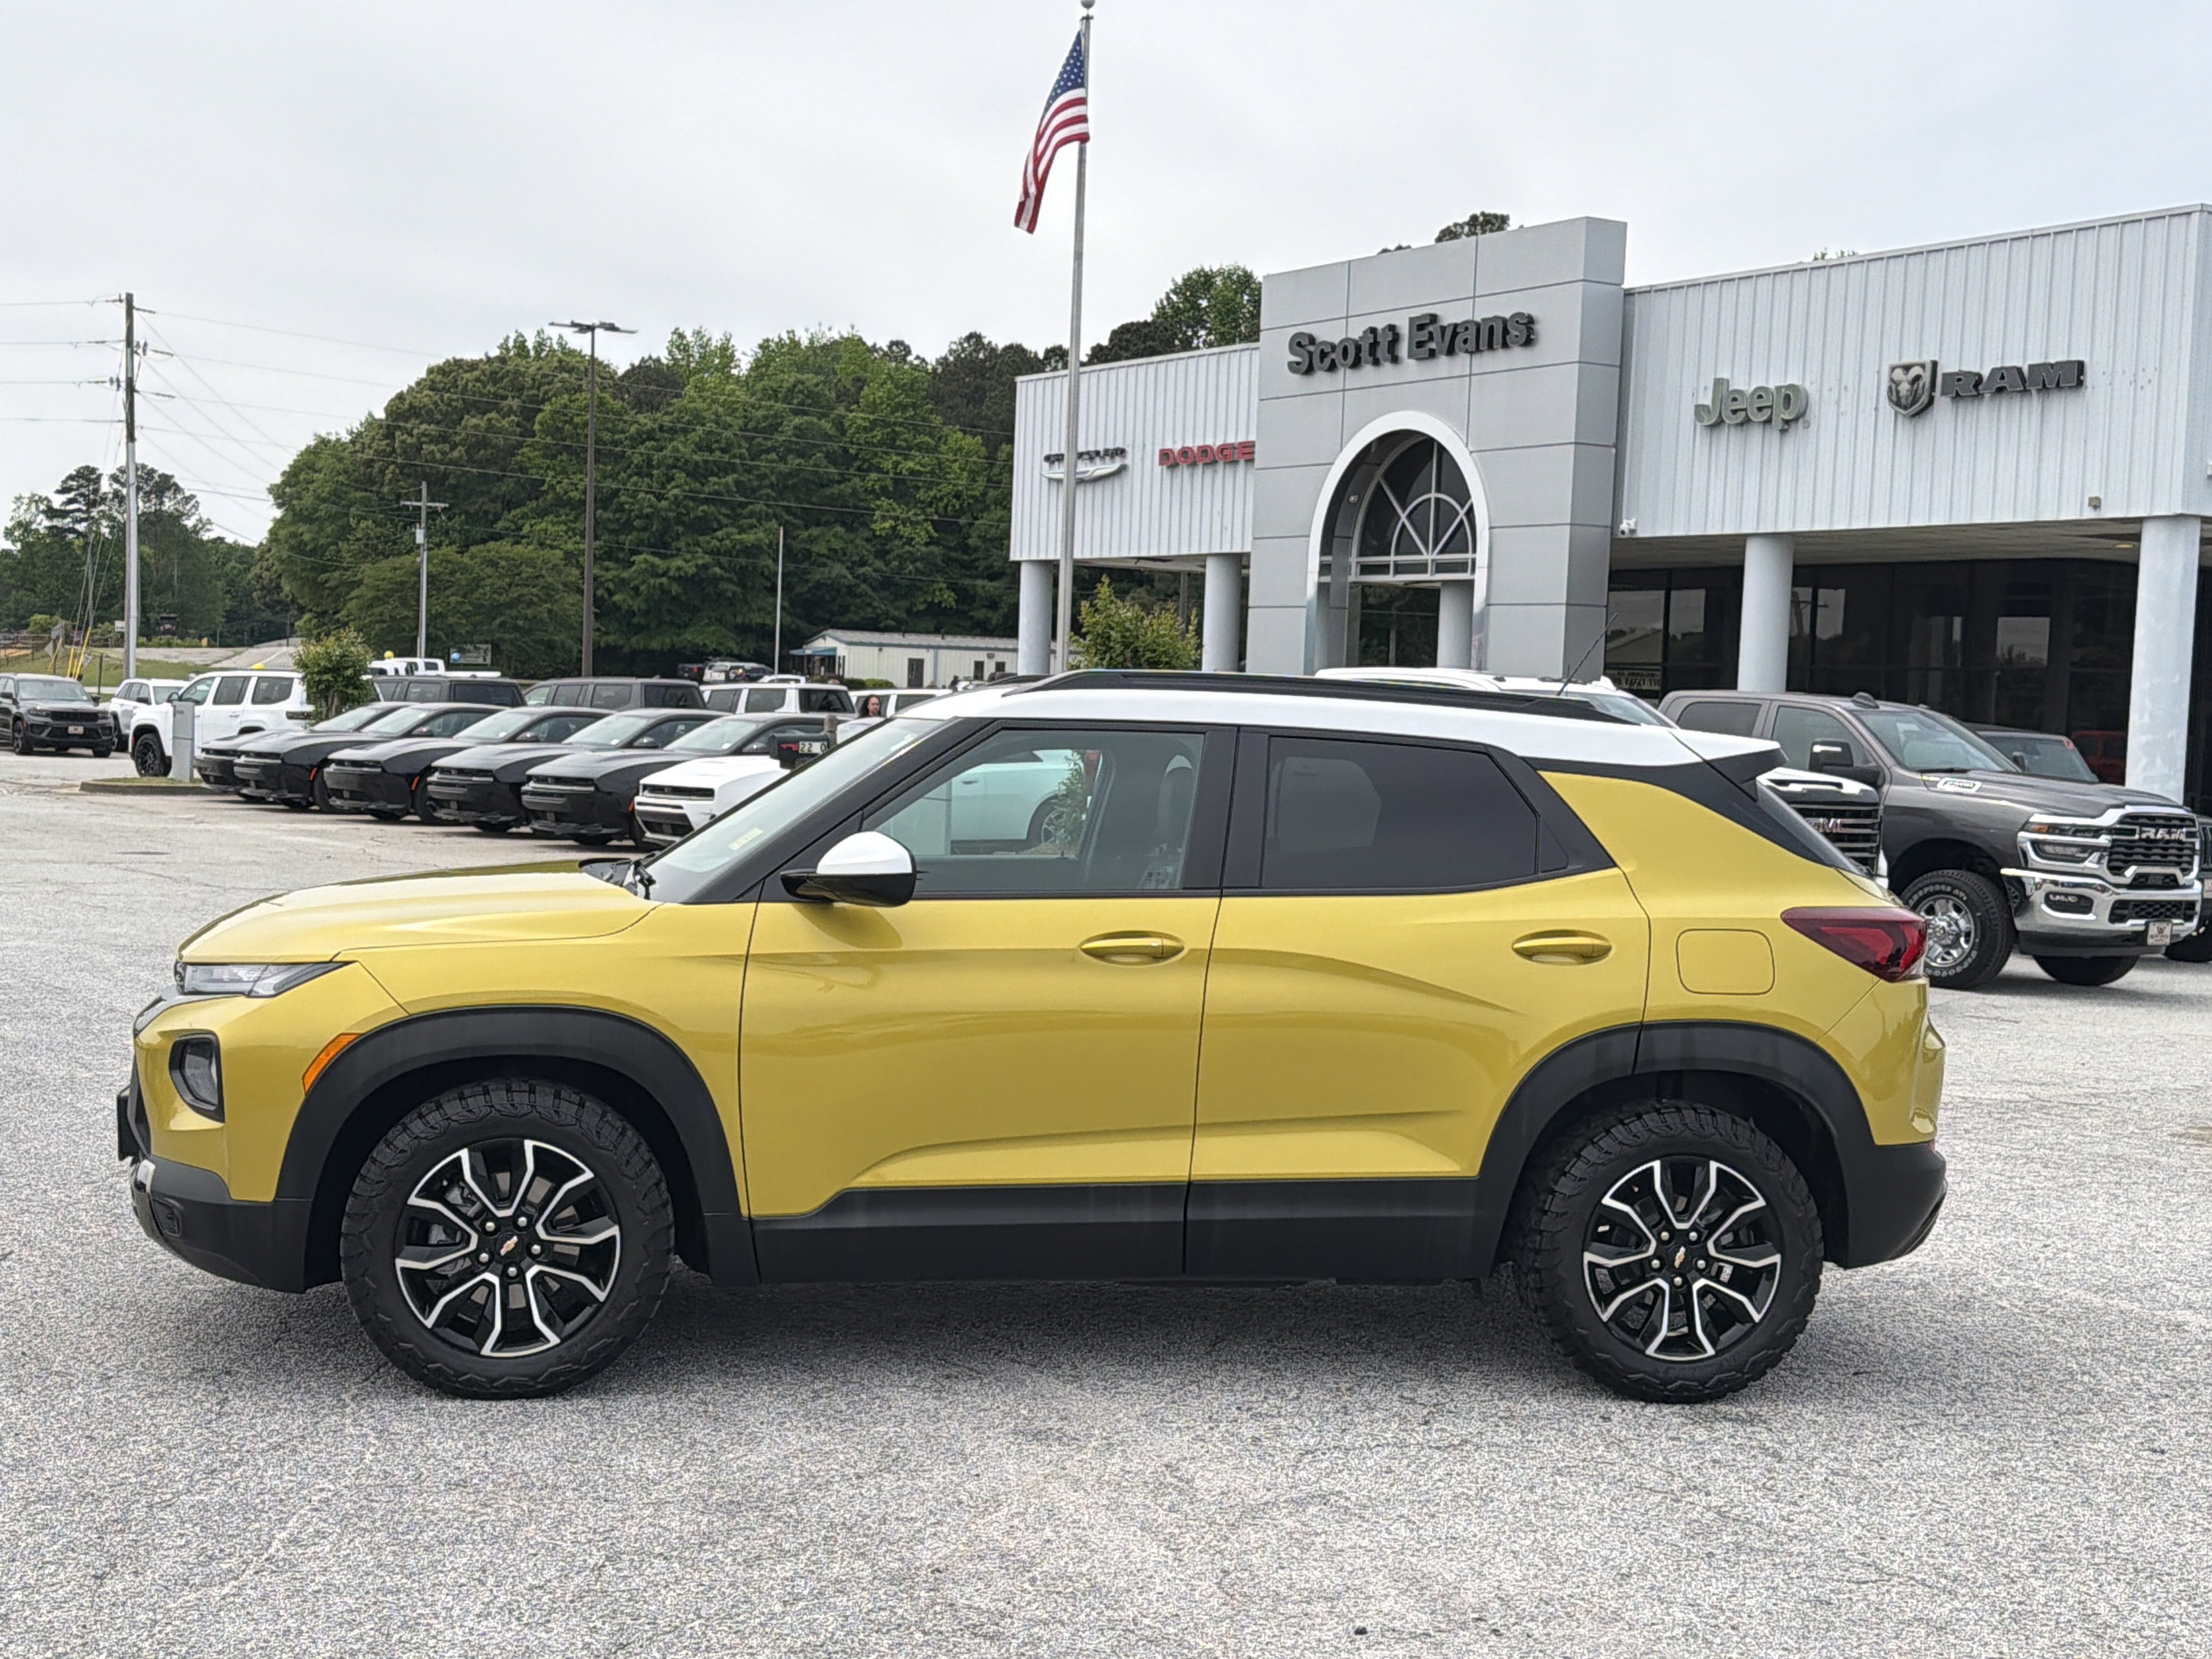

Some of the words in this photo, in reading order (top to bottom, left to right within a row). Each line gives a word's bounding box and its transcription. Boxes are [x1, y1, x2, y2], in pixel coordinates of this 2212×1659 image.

[1287, 324, 1400, 375] Scott
[1407, 312, 1535, 360] Evans
[1940, 360, 2085, 398] RAM
[1694, 377, 1809, 432] Jeep
[1159, 441, 1256, 467] DODGE
[2141, 827, 2186, 842] RAM
